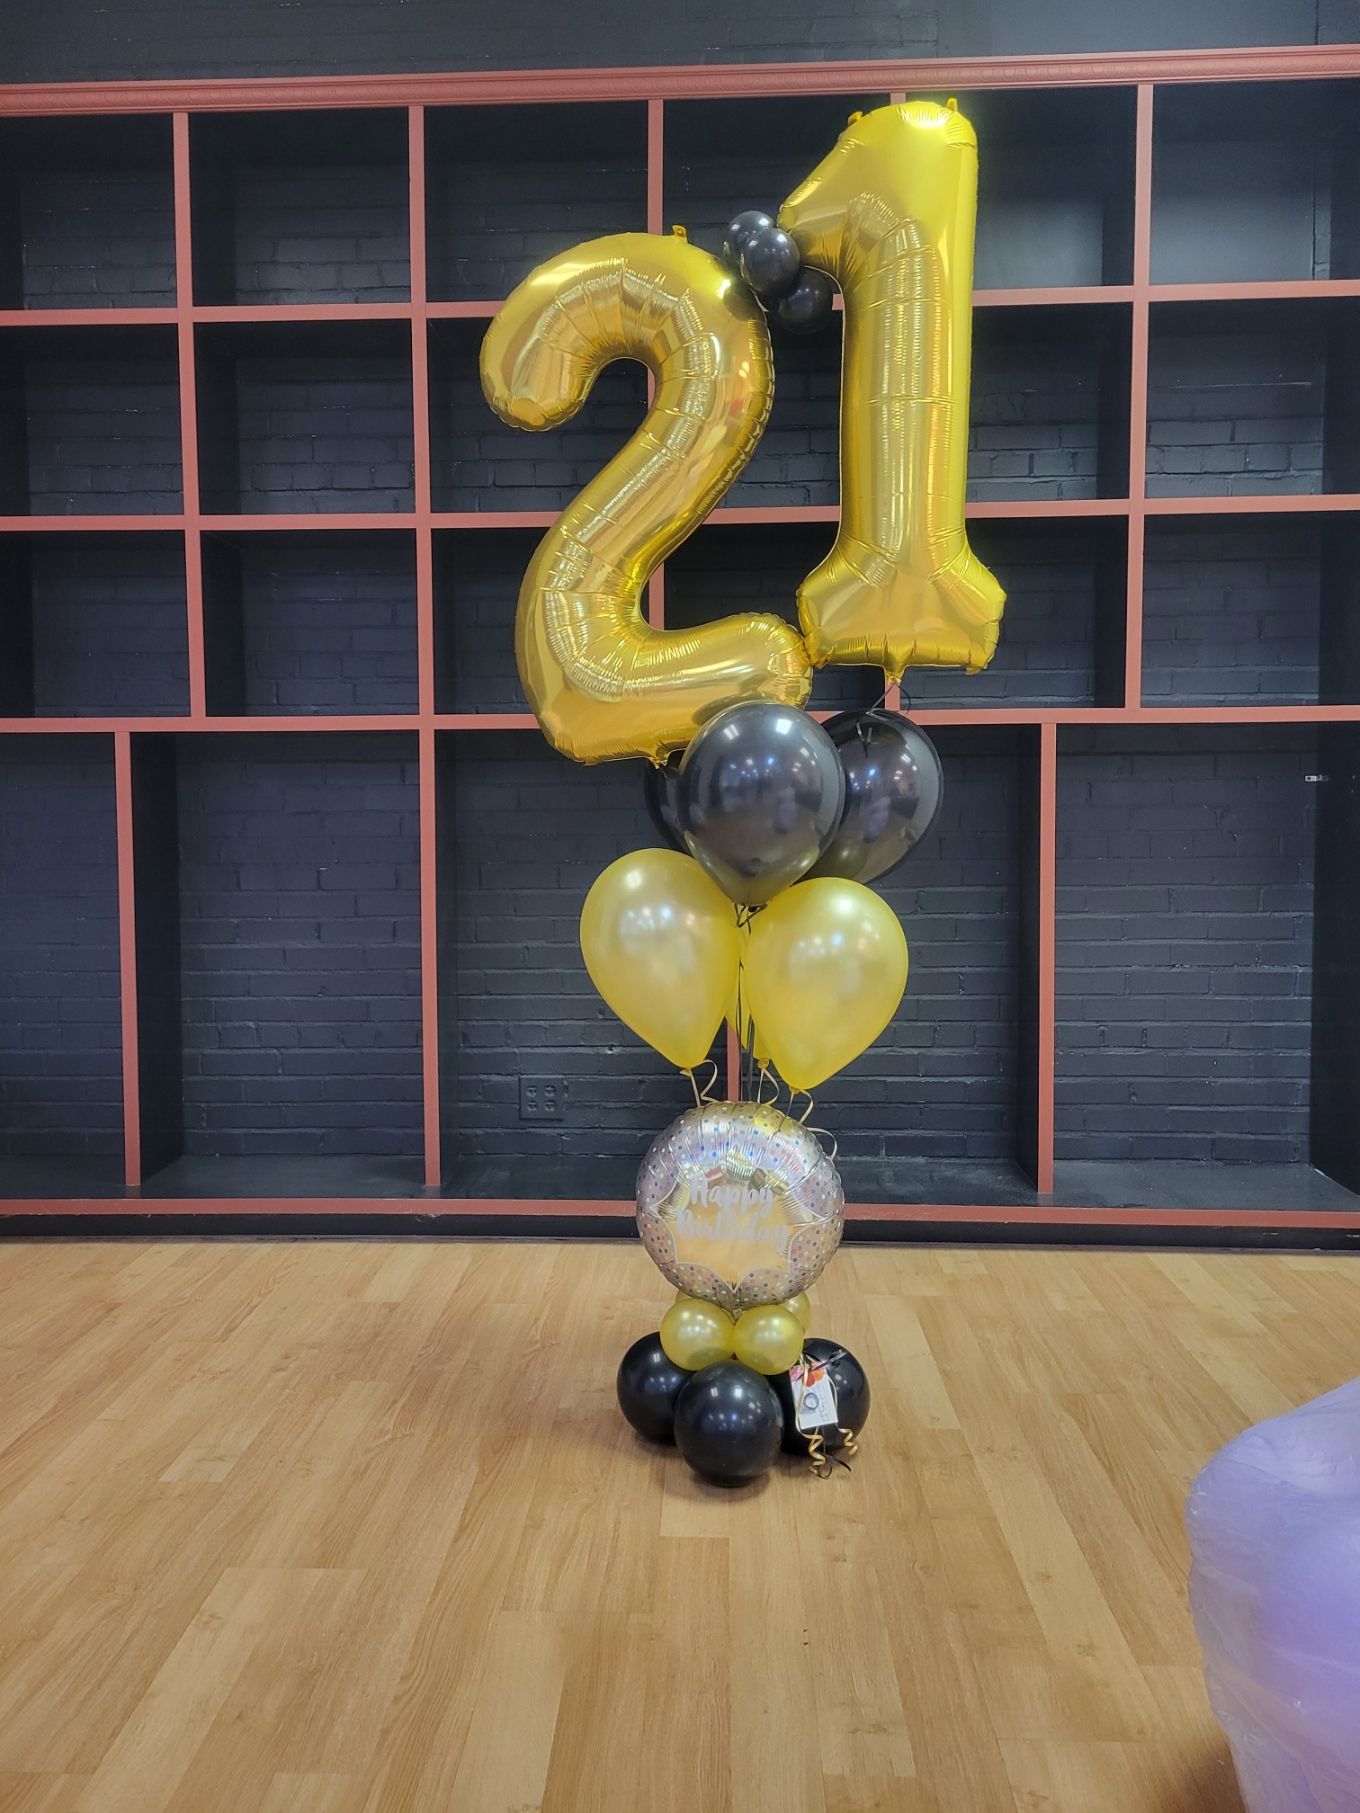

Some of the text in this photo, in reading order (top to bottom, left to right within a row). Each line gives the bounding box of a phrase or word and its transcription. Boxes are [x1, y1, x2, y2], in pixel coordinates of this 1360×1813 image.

[479, 99, 1007, 765] 21
[689, 1168, 774, 1218] Happy
[675, 1207, 790, 1257] Birthday
